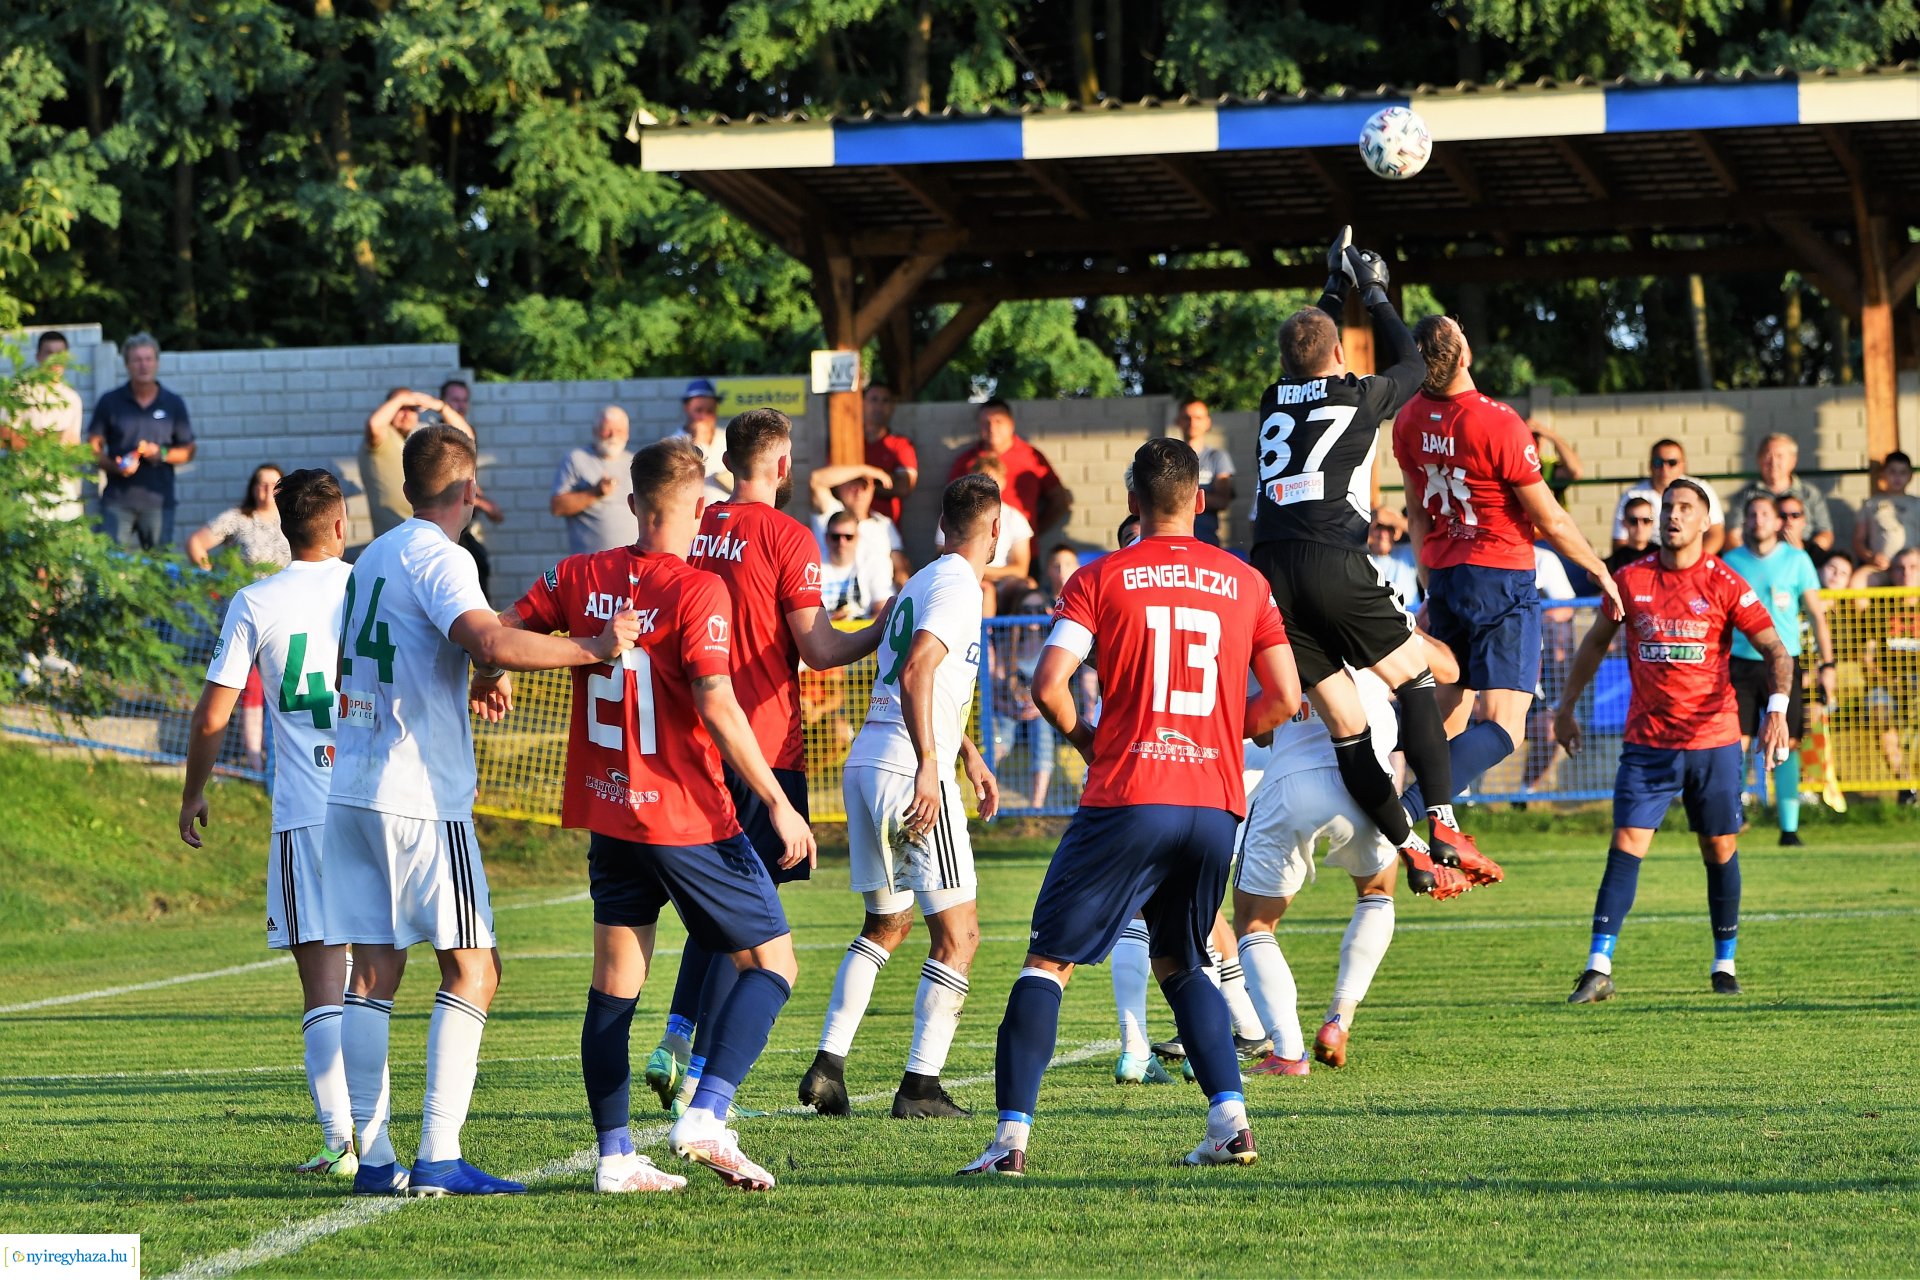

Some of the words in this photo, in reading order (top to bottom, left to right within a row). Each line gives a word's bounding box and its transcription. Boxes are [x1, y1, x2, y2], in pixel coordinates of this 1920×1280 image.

[1277, 379, 1328, 405] VERPECZ
[1259, 405, 1358, 481] 87
[1421, 432, 1455, 457] BAKI
[688, 531, 749, 562] OVÁK
[1123, 564, 1238, 600] GENGELICZKI
[584, 592, 660, 634] ADAEK
[877, 596, 914, 686] 9
[1146, 606, 1221, 717] 13
[279, 633, 334, 729] 4
[587, 640, 657, 755] 21
[1141, 752, 1204, 764] HUNGARY
